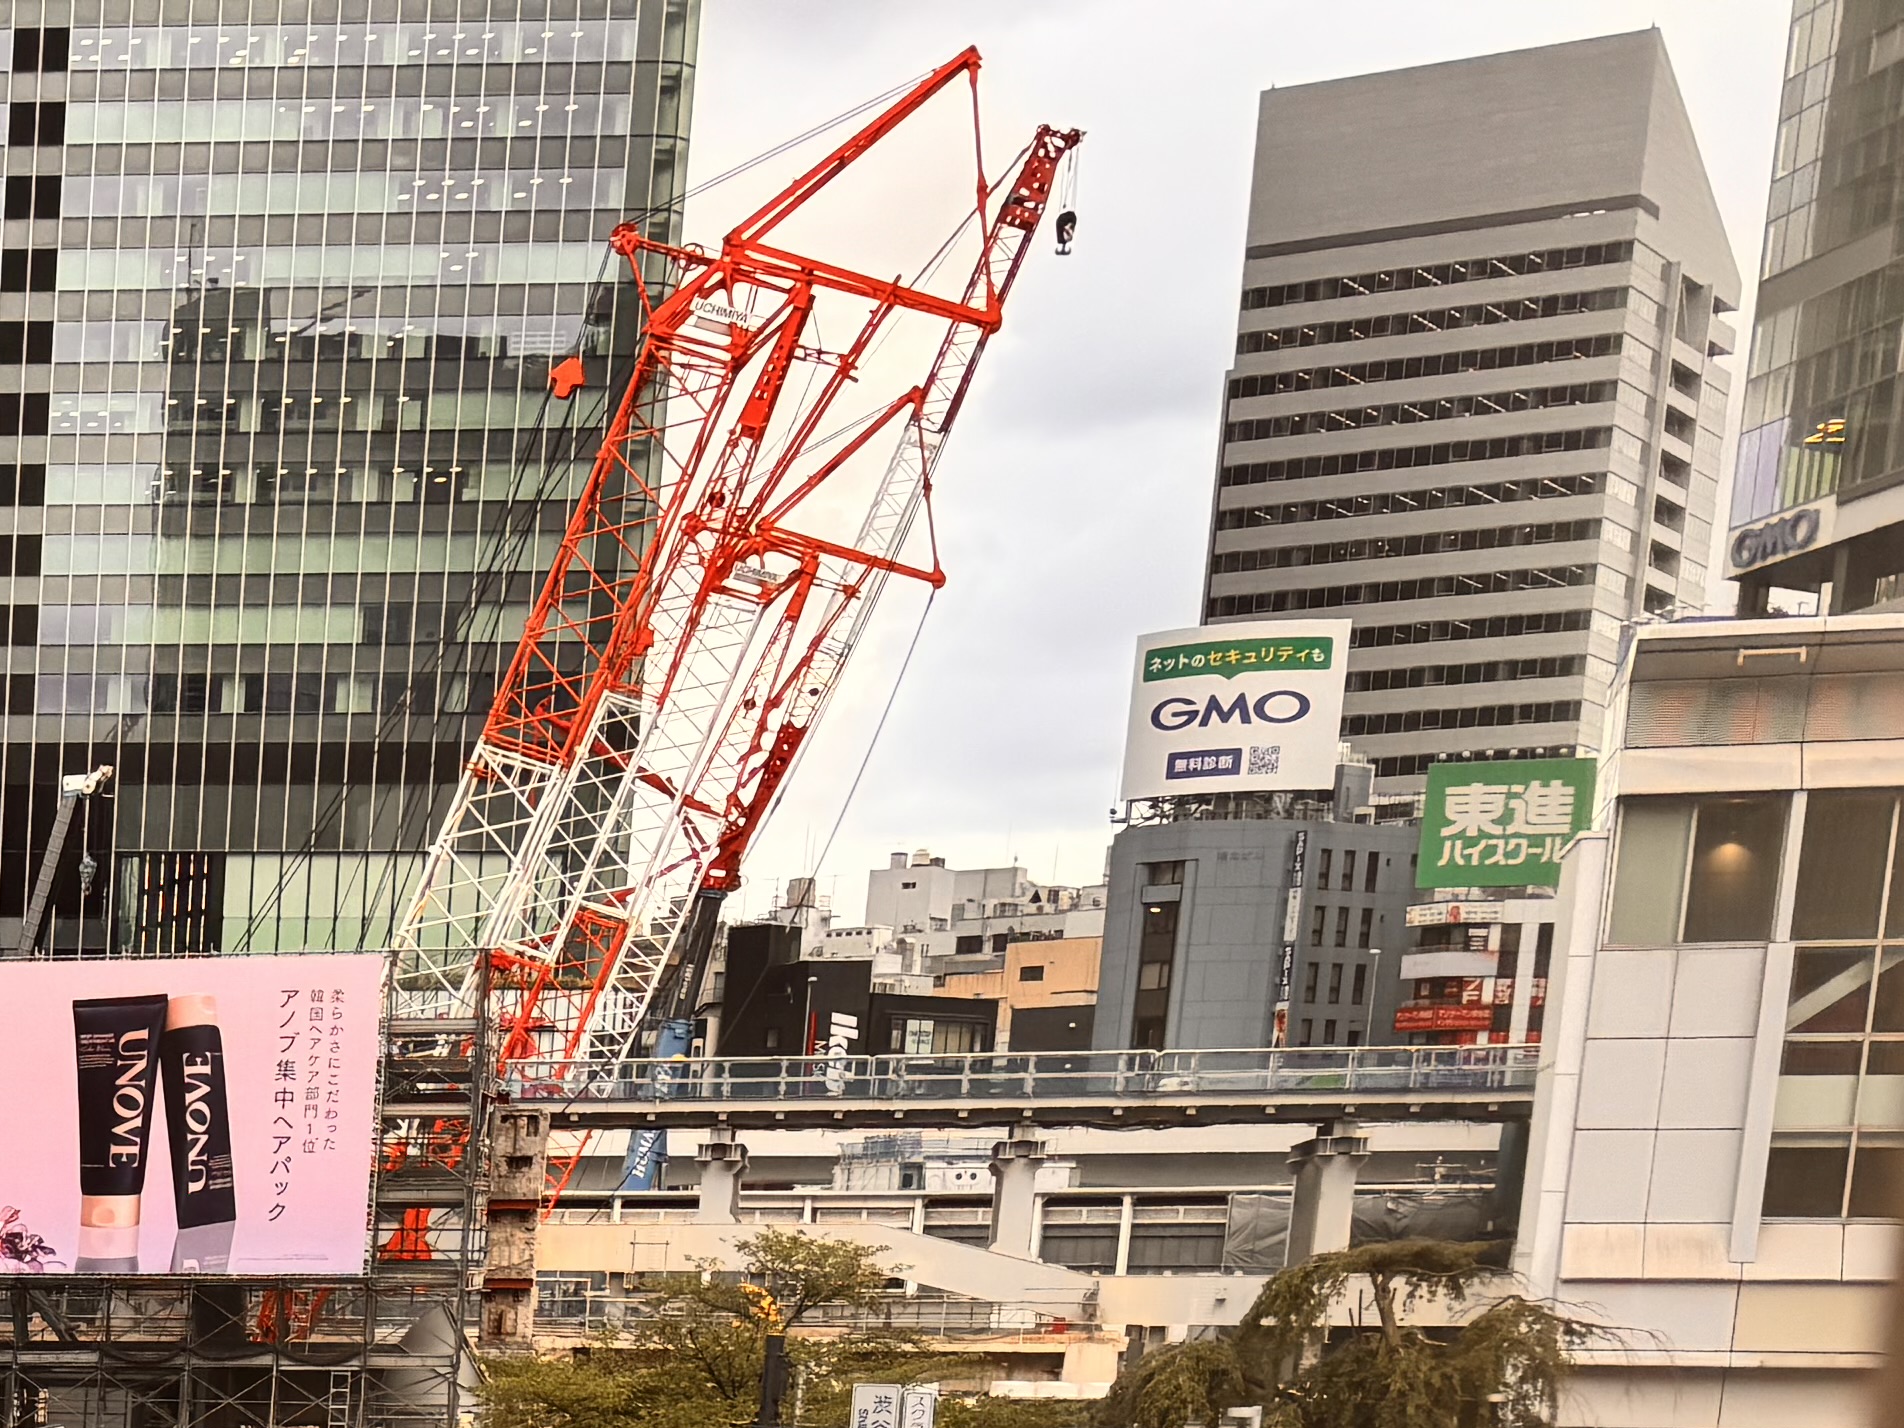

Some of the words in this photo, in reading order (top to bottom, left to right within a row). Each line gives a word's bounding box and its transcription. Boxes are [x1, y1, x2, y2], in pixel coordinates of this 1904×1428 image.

[1731, 509, 1820, 569] GMO
[1148, 646, 1325, 672] ネットのセキュリティも
[1150, 689, 1311, 731] GMO
[1174, 755, 1234, 773] 無料診断
[1440, 780, 1576, 837] 東進
[1438, 838, 1566, 867] ハイスクール
[109, 1027, 150, 1168] UNOVE
[323, 988, 344, 1151] 柔らかさにこだわった
[182, 1051, 212, 1194] UNOVE
[268, 989, 299, 1222] アノブ集中ヘアパック
